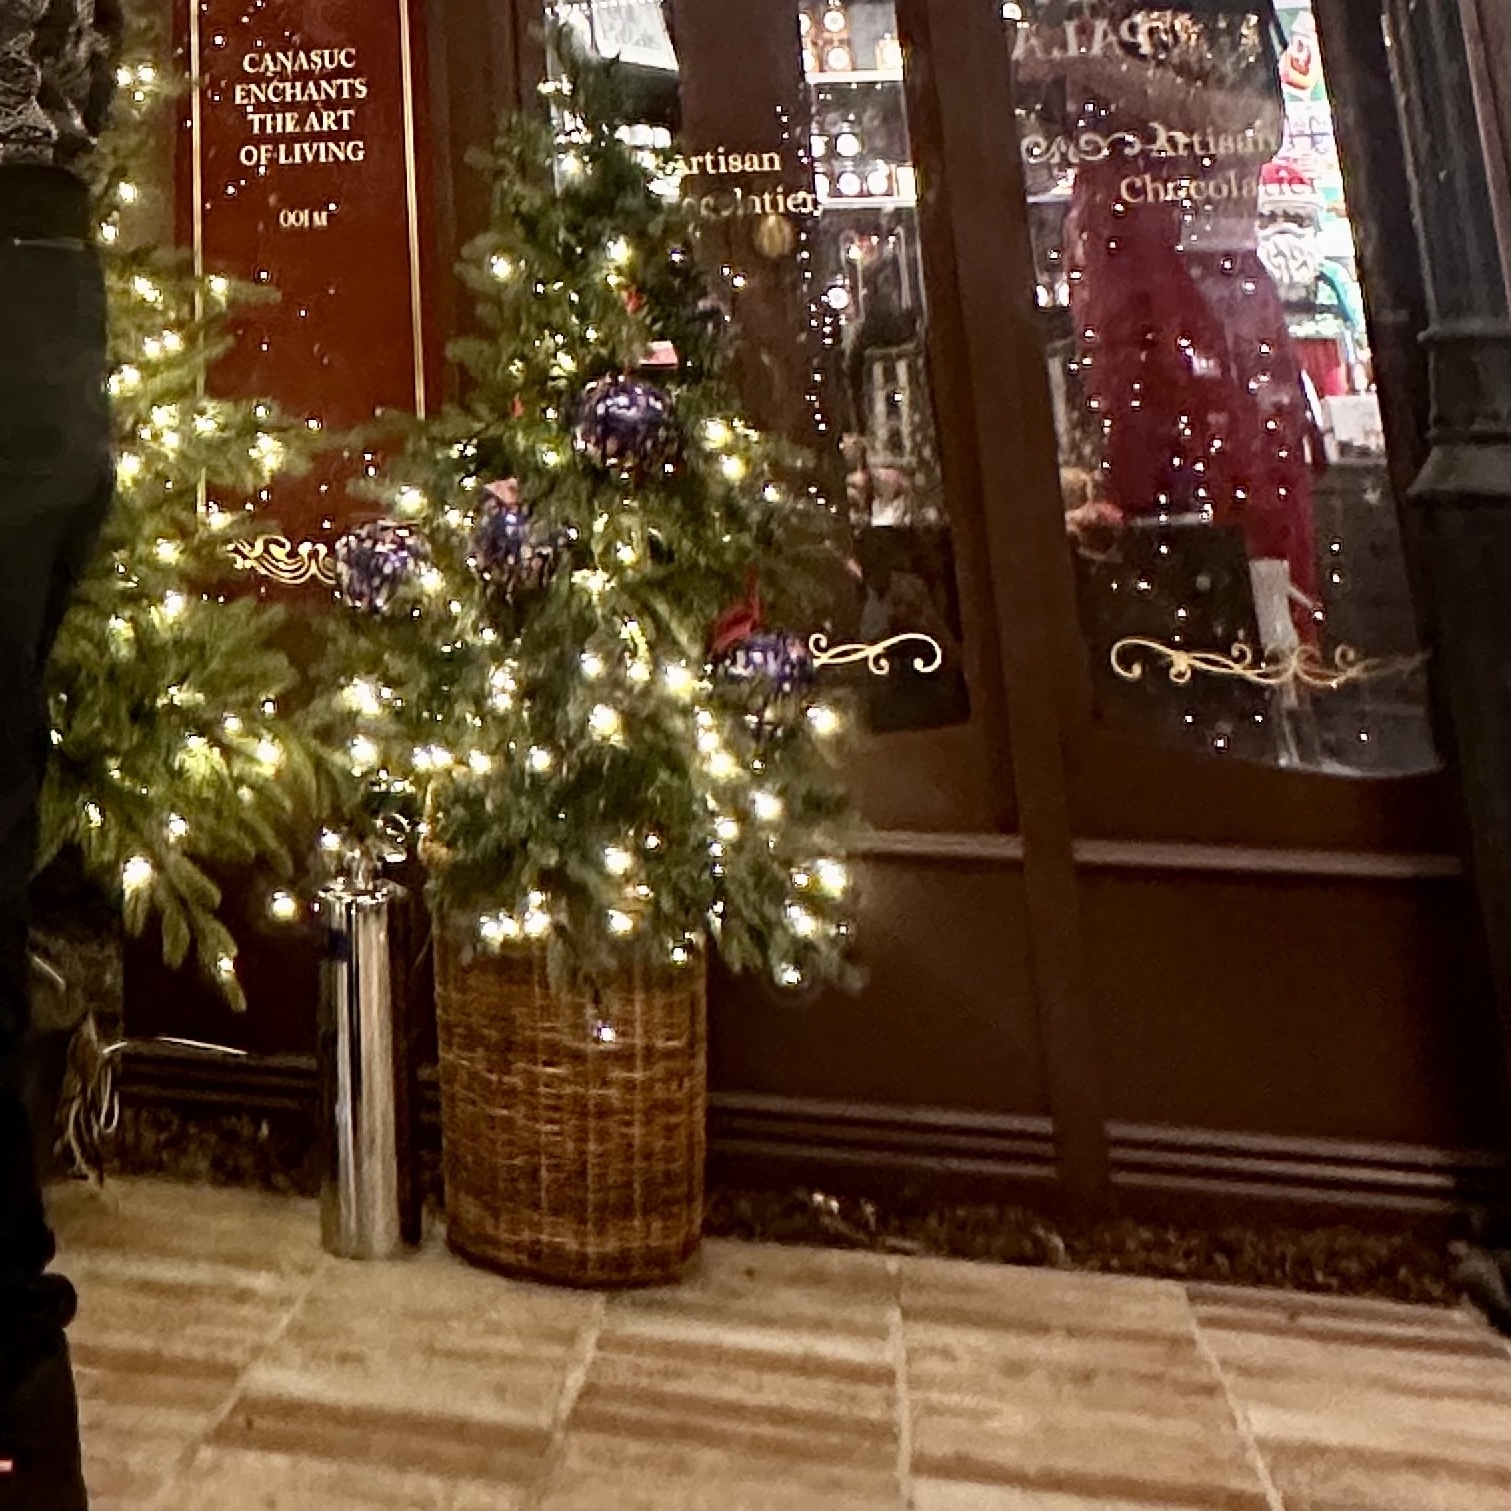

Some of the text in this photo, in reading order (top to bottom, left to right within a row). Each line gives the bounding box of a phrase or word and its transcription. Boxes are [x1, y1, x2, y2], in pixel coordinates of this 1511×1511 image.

[242, 47, 356, 74] CANASUC
[234, 78, 368, 105] ENCHANTS
[247, 110, 356, 134] THE ART
[240, 141, 366, 167] OF LIVING
